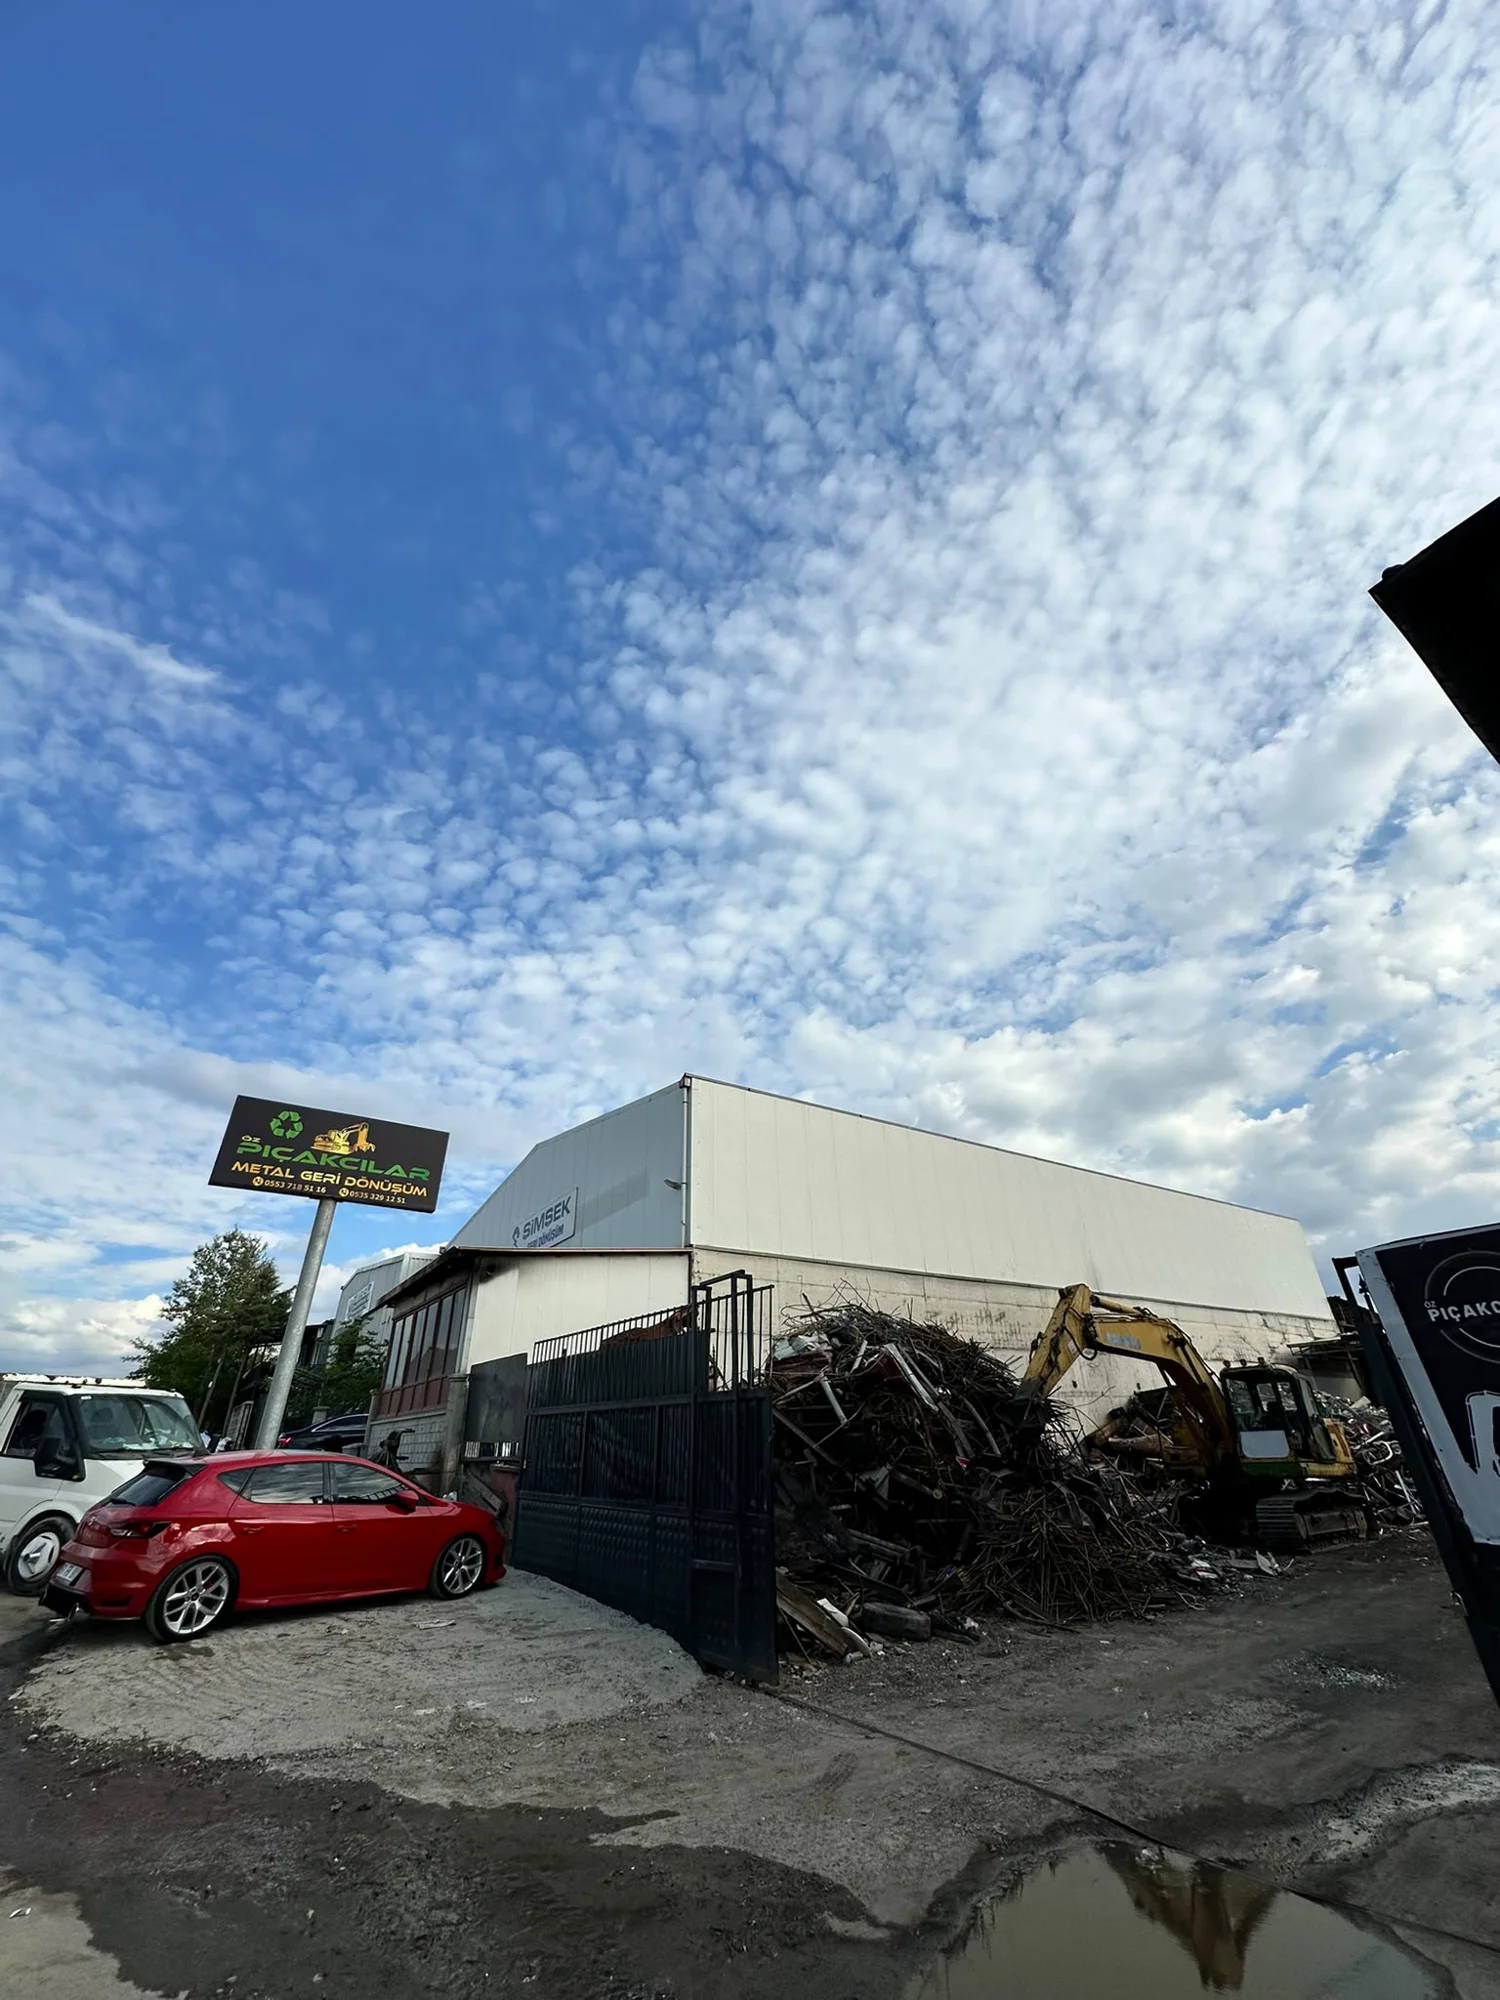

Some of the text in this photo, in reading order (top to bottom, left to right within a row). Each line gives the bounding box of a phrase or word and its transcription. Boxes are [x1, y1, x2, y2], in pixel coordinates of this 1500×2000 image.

[242, 1134, 261, 1143] ÖZ
[236, 1142, 430, 1181] PIÇAKCILAR
[231, 1161, 427, 1197] METAL GERİ DÖNÜŞÜM
[264, 1179, 285, 1188] 0553
[349, 1190, 369, 1199] 0535
[396, 1196, 406, 1204] 51
